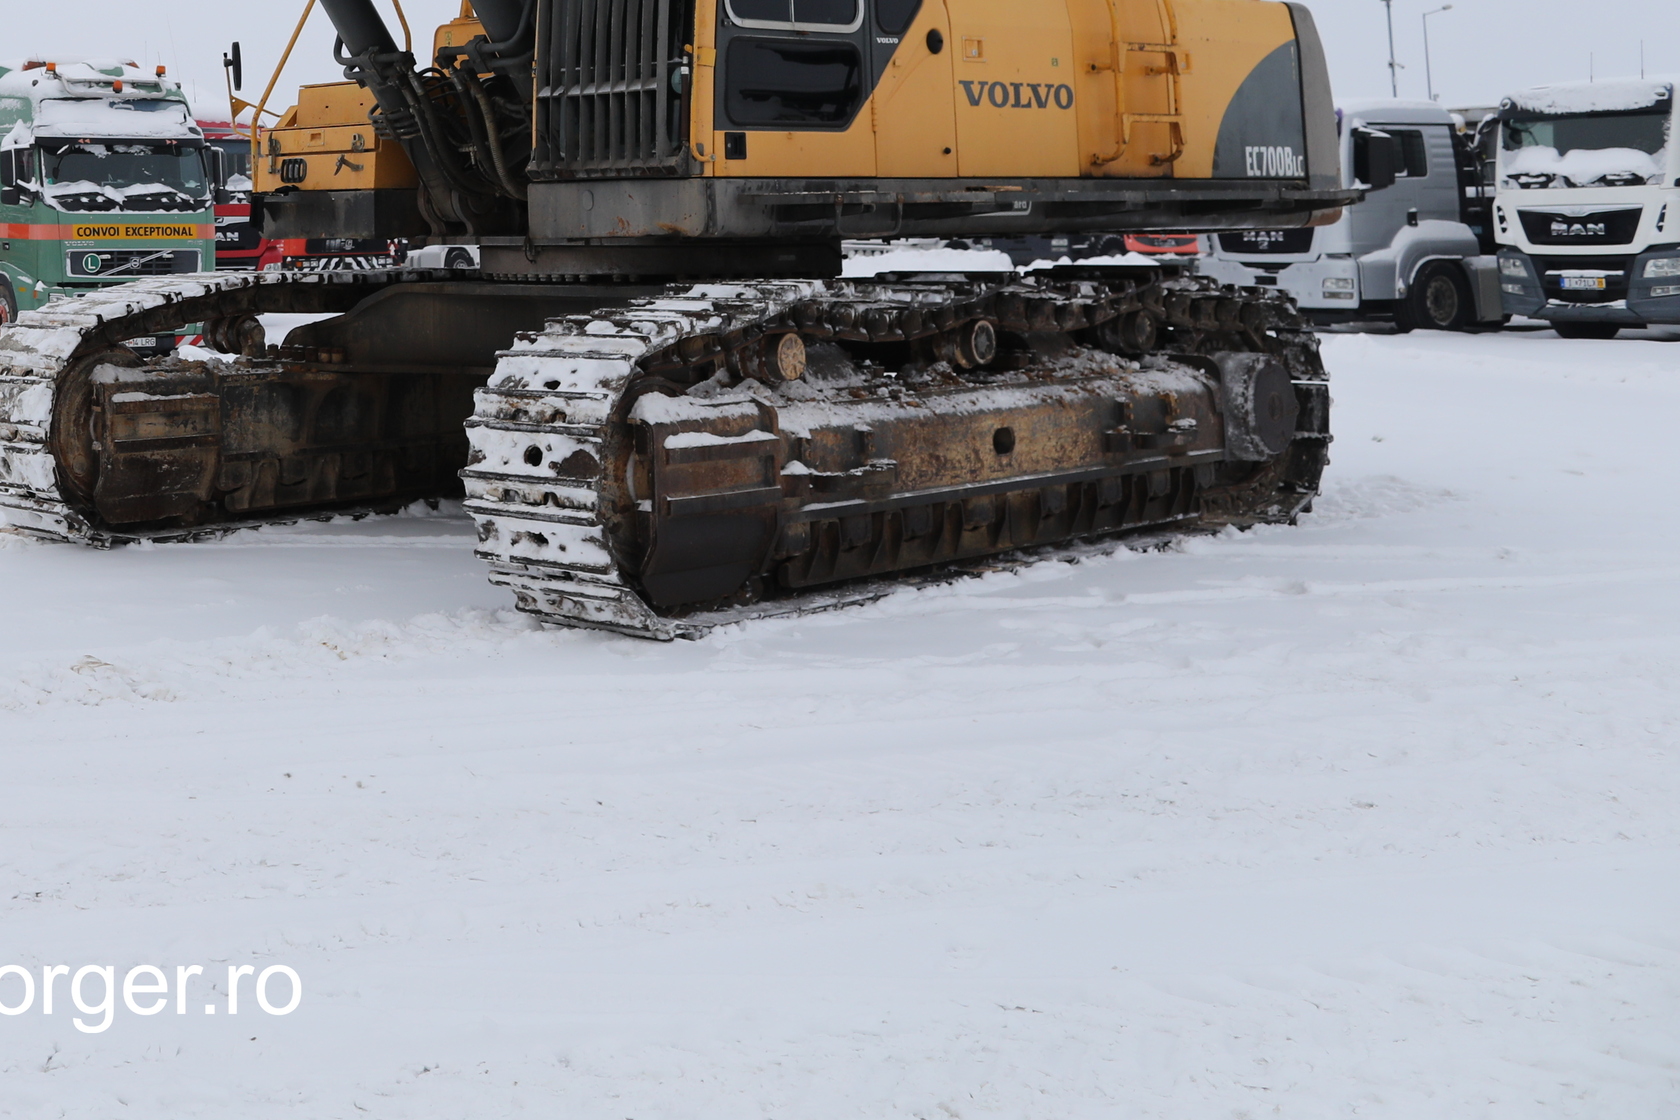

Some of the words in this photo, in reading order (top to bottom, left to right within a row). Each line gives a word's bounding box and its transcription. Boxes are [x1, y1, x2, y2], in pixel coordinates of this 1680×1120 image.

[958, 80, 1074, 110] VOLVO
[1245, 146, 1304, 177] EC700BLC
[76, 226, 120, 237] CONVOI
[125, 225, 193, 237] EXCEPTIONAL
[1550, 222, 1605, 235] MAN
[215, 232, 239, 241] AN
[1243, 231, 1284, 241] MAN
[87, 257, 96, 269] L
